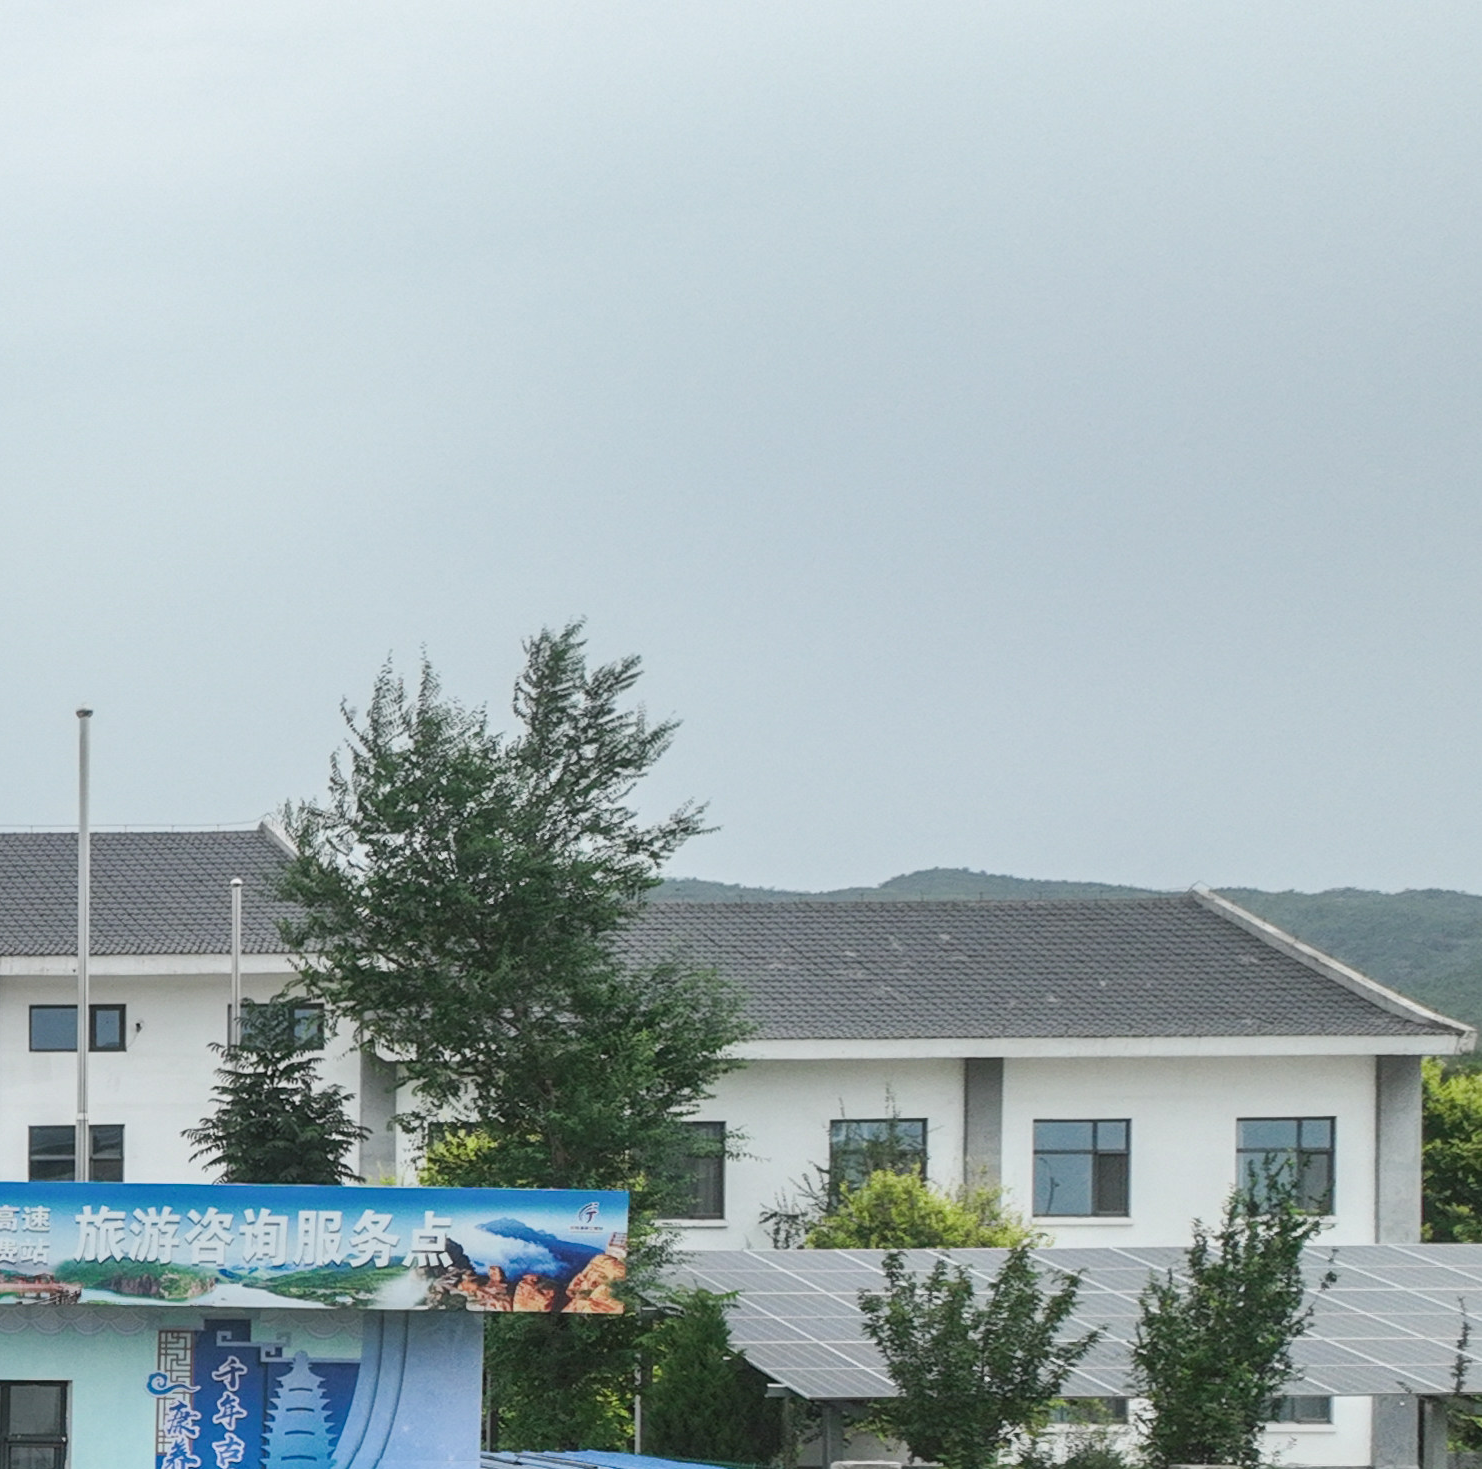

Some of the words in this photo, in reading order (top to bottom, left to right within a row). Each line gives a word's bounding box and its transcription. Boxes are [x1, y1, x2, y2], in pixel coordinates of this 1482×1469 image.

[74, 1205, 454, 1268] 旅游咨询服务点
